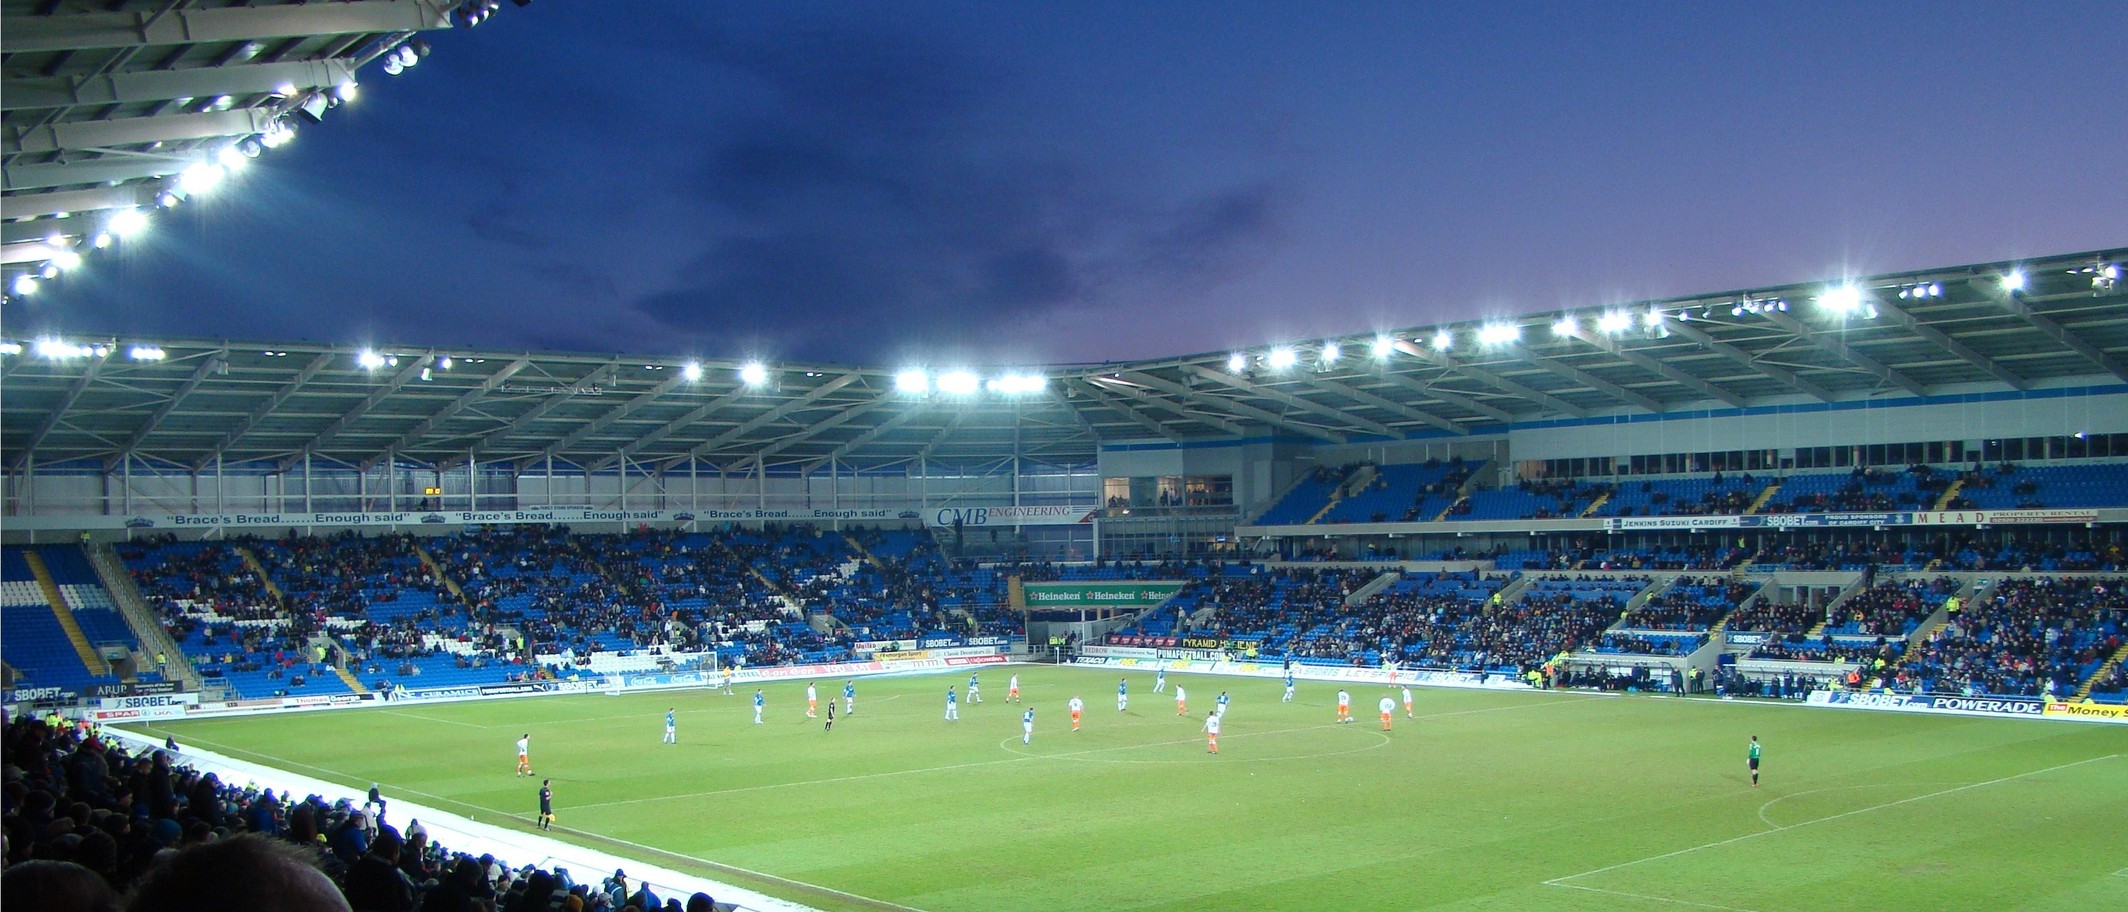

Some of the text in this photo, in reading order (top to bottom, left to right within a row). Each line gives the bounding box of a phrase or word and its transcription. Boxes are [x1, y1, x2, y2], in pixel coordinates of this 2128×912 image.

[937, 506, 1070, 525] CMB ENGINEERING
[1767, 516, 1818, 526] SBOBET.com
[1038, 591, 1080, 600] Heineken
[1095, 591, 1135, 600] Heineken
[1183, 639, 1216, 648] PYRAMID
[97, 685, 127, 695] ARUP
[421, 689, 478, 698] CERAMICS
[1848, 692, 1928, 708] SBOBET.com
[2068, 706, 2119, 718] Money
